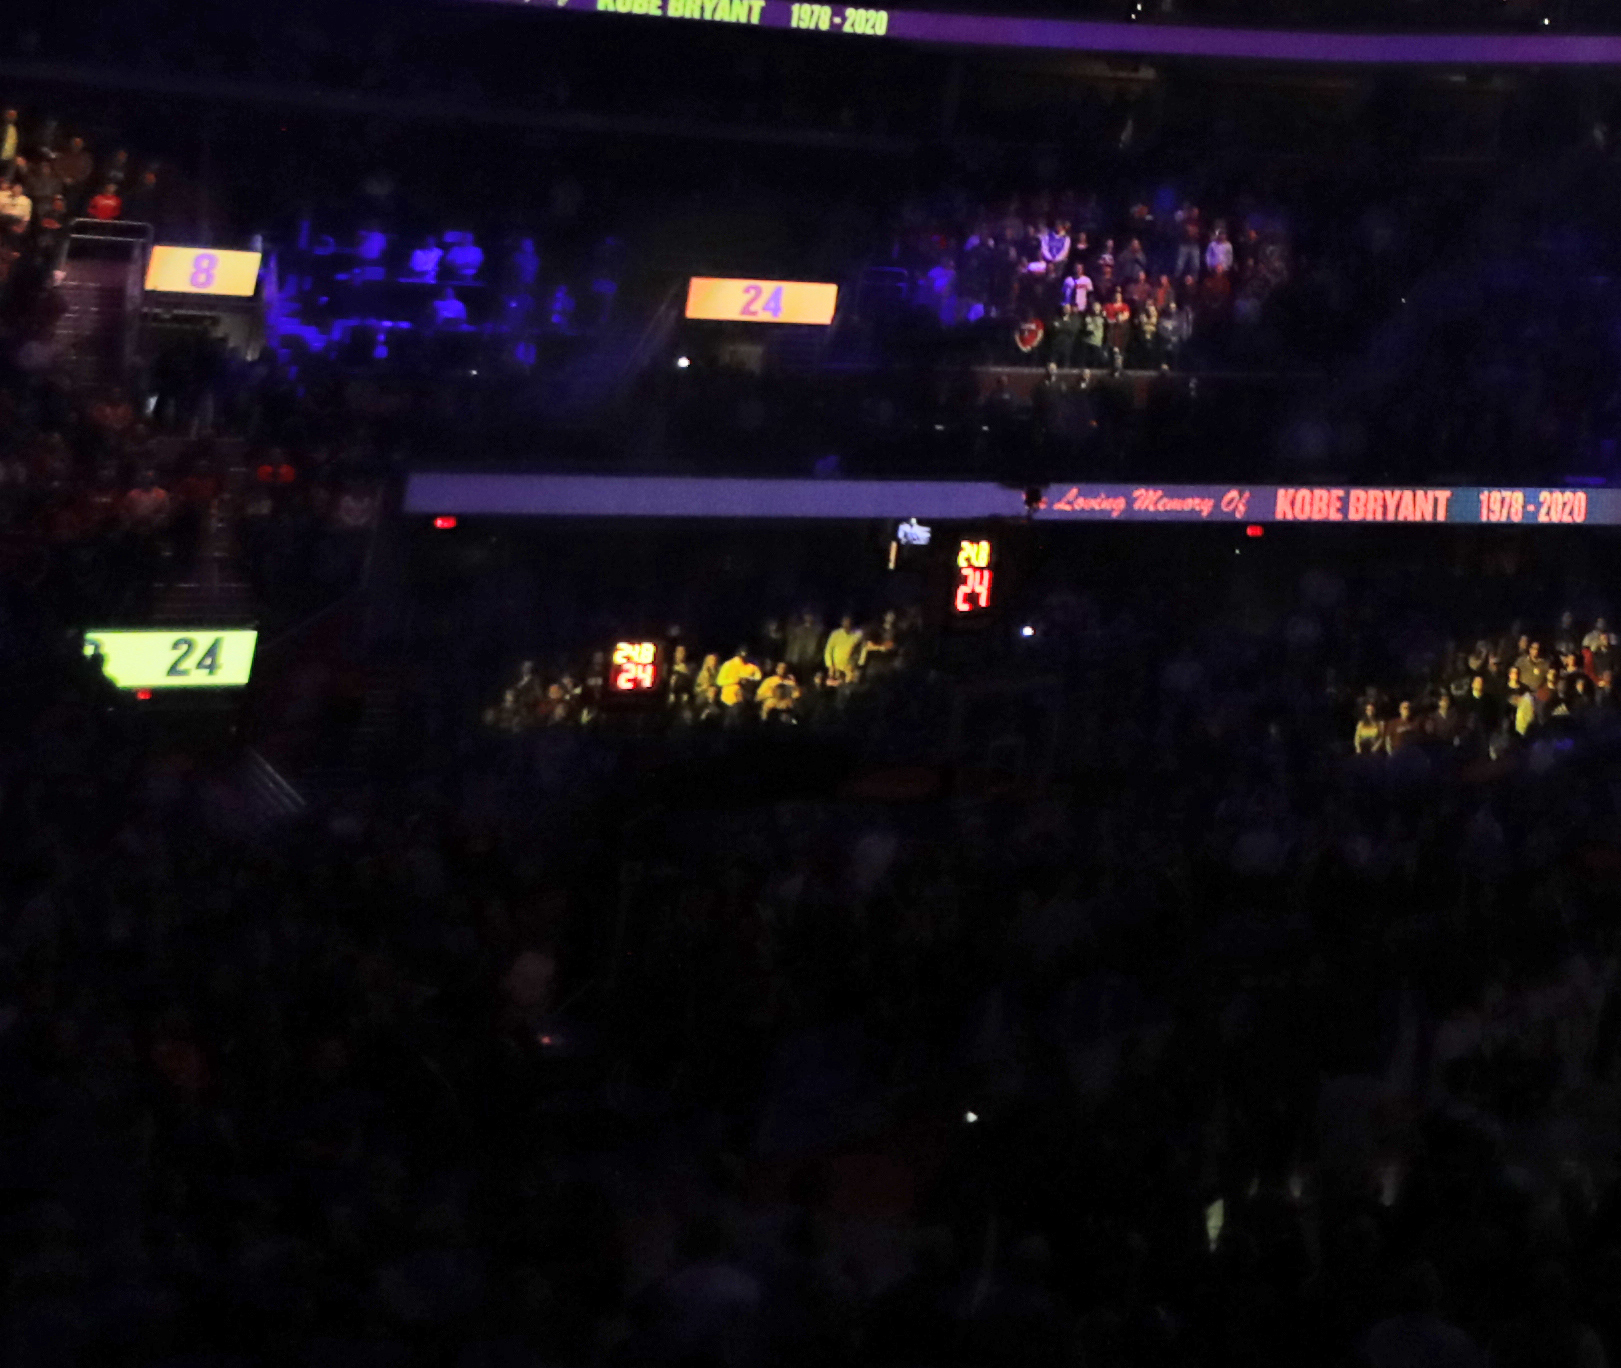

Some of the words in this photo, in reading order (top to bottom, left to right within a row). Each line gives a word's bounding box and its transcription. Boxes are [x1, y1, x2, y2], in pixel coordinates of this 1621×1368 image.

[790, 3, 830, 30] 1978
[843, 8, 888, 35] 2020
[190, 252, 218, 289] 8
[740, 285, 784, 319] 24
[1053, 488, 1126, 517] Loving
[1132, 489, 1214, 517] Memory
[1220, 489, 1251, 518] Of
[1275, 489, 1343, 521] KOBE
[1347, 489, 1450, 521] BRYANT
[1478, 491, 1522, 522] 1978
[1537, 491, 1587, 523] 2020
[955, 567, 993, 612] 24
[166, 637, 224, 676] 24
[617, 663, 655, 690] 24
